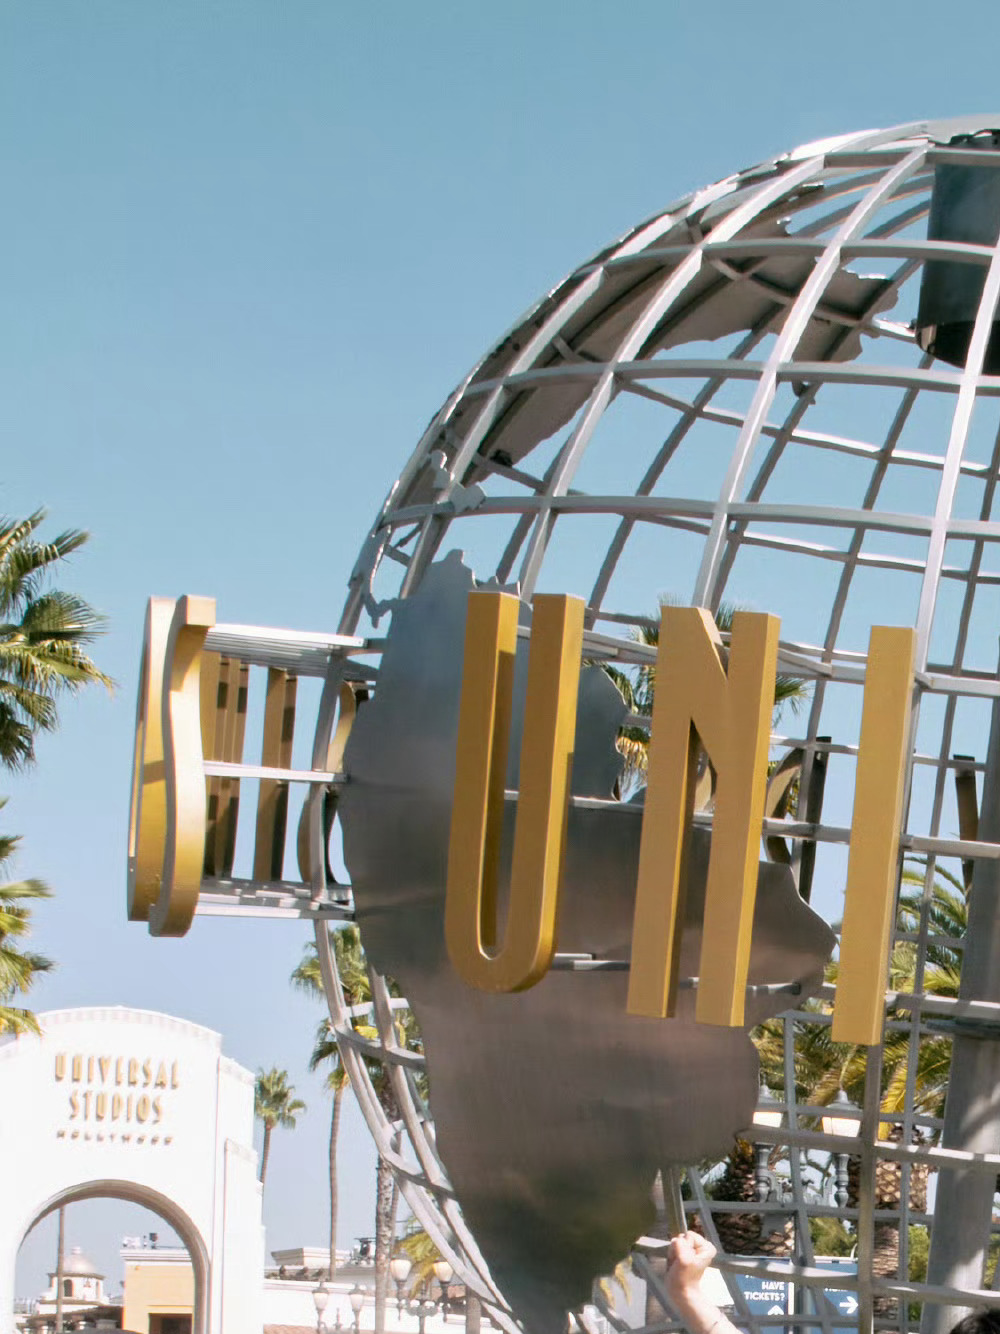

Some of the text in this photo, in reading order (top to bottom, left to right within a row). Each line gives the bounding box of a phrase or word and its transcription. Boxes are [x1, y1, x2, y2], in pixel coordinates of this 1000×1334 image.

[55, 1052, 180, 1089] UNIVERSAL
[69, 1090, 164, 1124] STUDIOS
[743, 1291, 786, 1302] TICKETS?
[761, 1281, 785, 1291] HAVE
